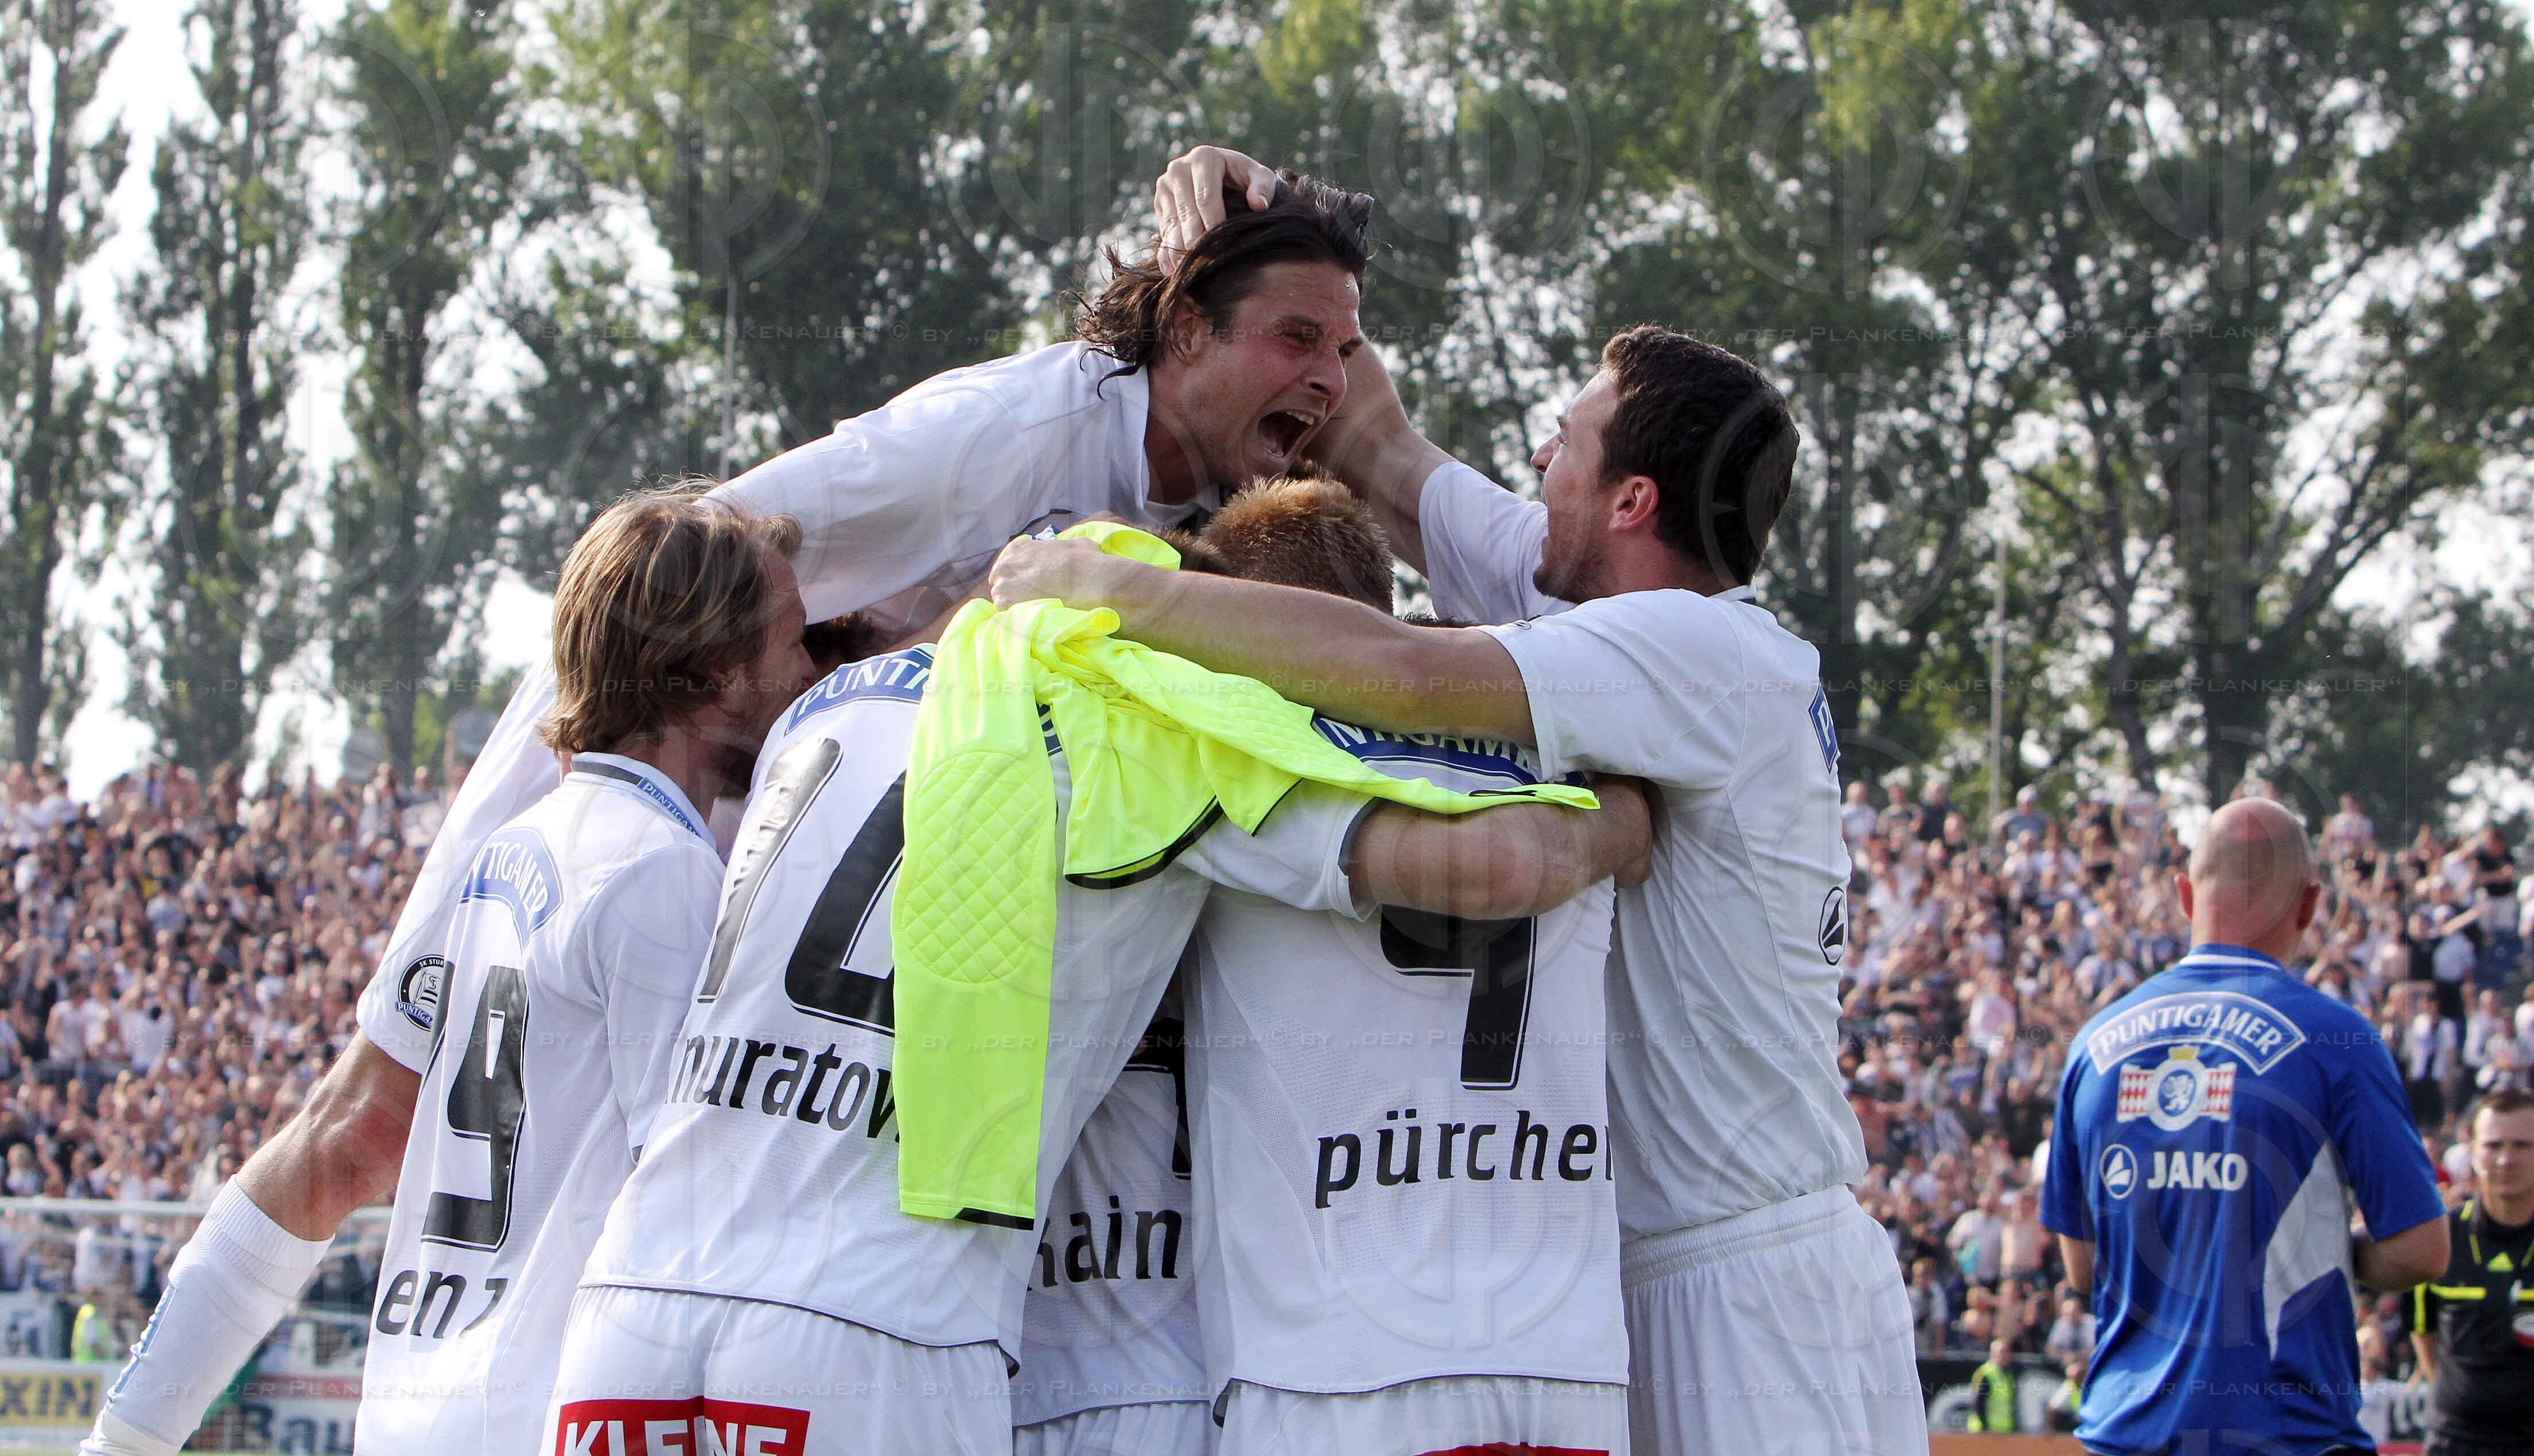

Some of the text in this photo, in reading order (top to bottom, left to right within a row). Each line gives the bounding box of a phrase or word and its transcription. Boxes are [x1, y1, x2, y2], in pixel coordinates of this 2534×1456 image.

[2098, 1003, 2282, 1056] PUNTIGAMER
[1315, 1108, 1612, 1209] pürche
[2147, 1151, 2248, 1190] JAKO
